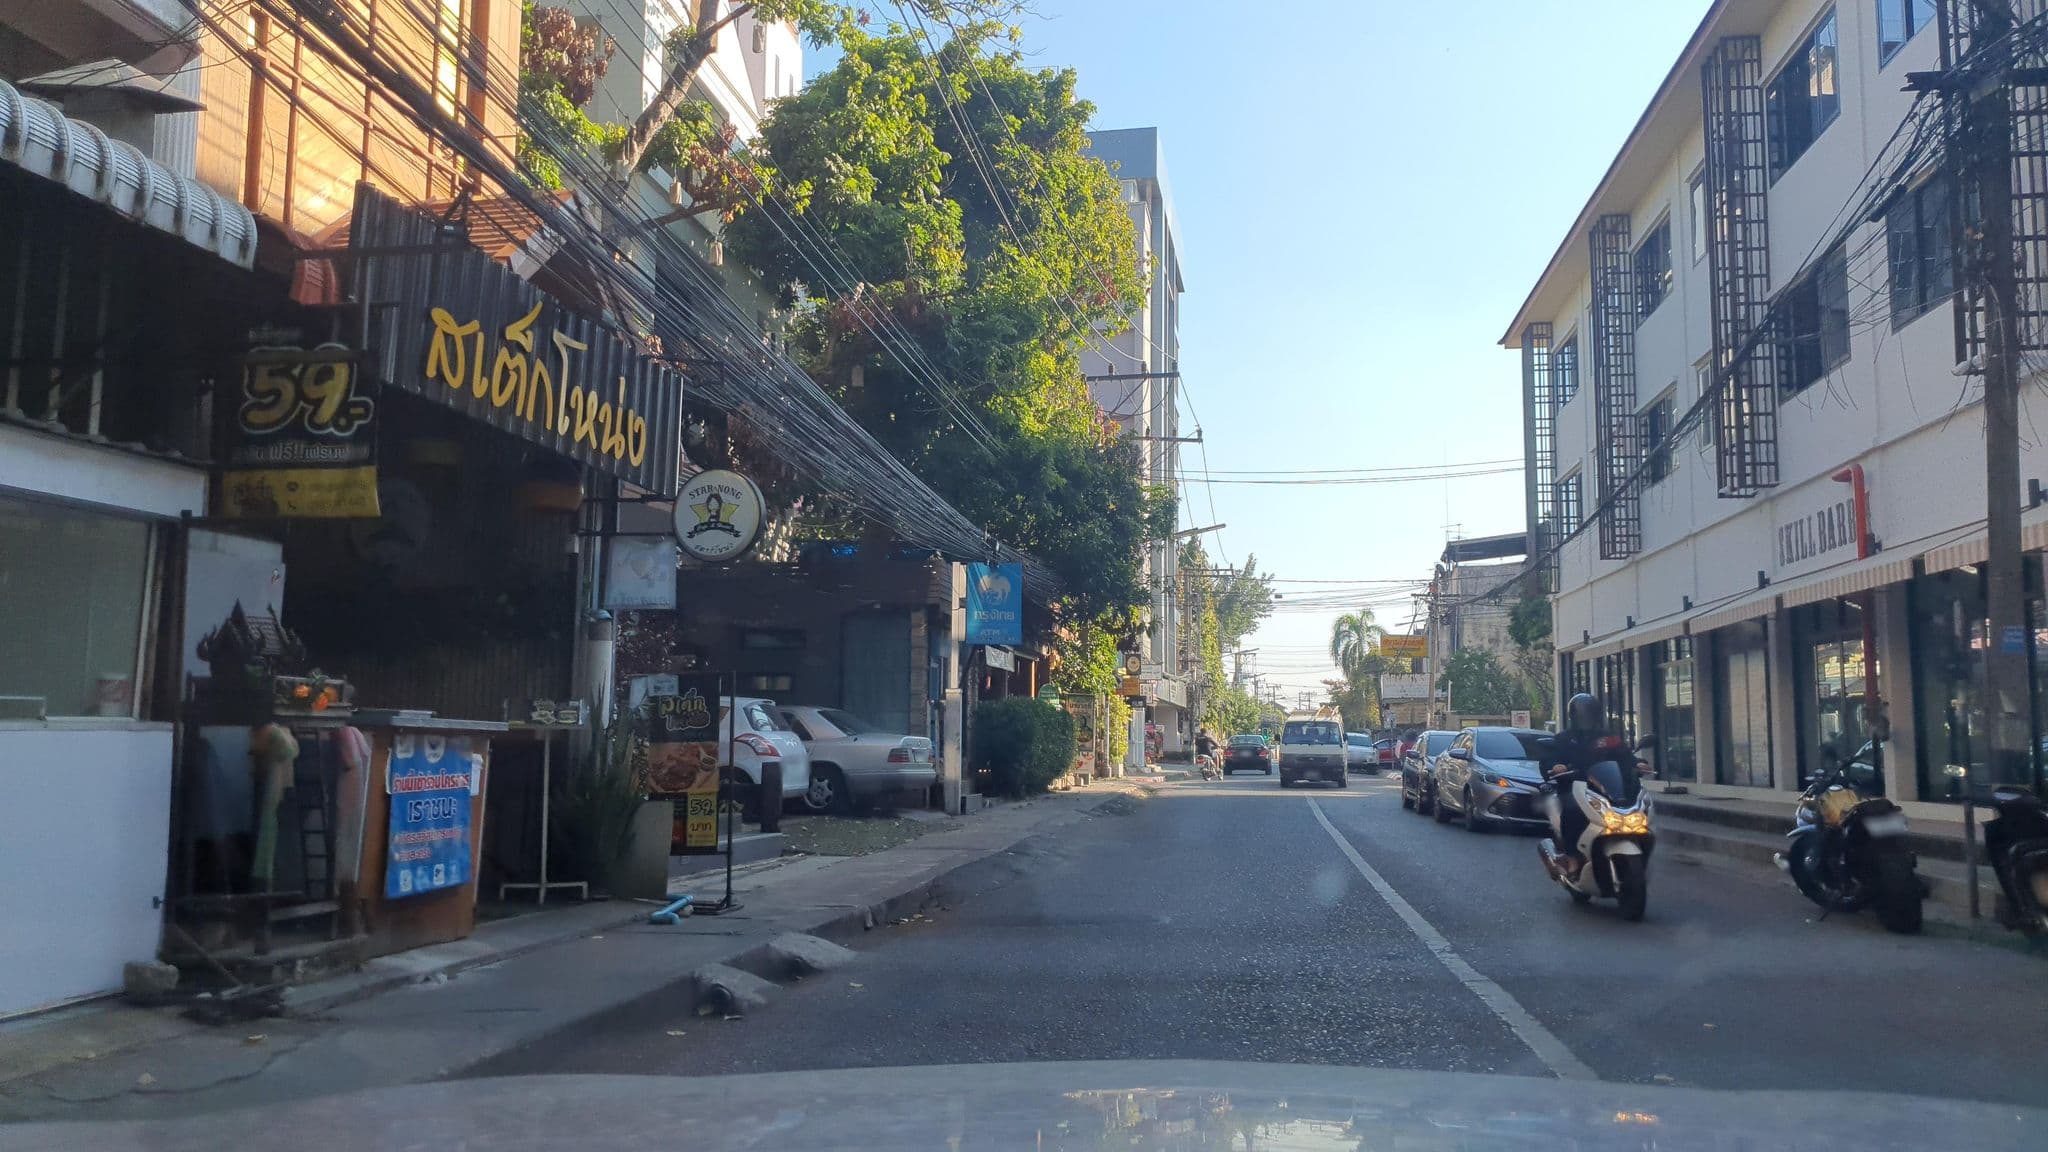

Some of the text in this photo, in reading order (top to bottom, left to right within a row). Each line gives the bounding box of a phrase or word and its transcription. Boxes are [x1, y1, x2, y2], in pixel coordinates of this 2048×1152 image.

[425, 301, 647, 467] สเต็กโหน่ง
[688, 484, 743, 500] STAR NONG
[1778, 490, 1873, 567] SKILL BARB
[407, 797, 458, 824] เราชนะ
